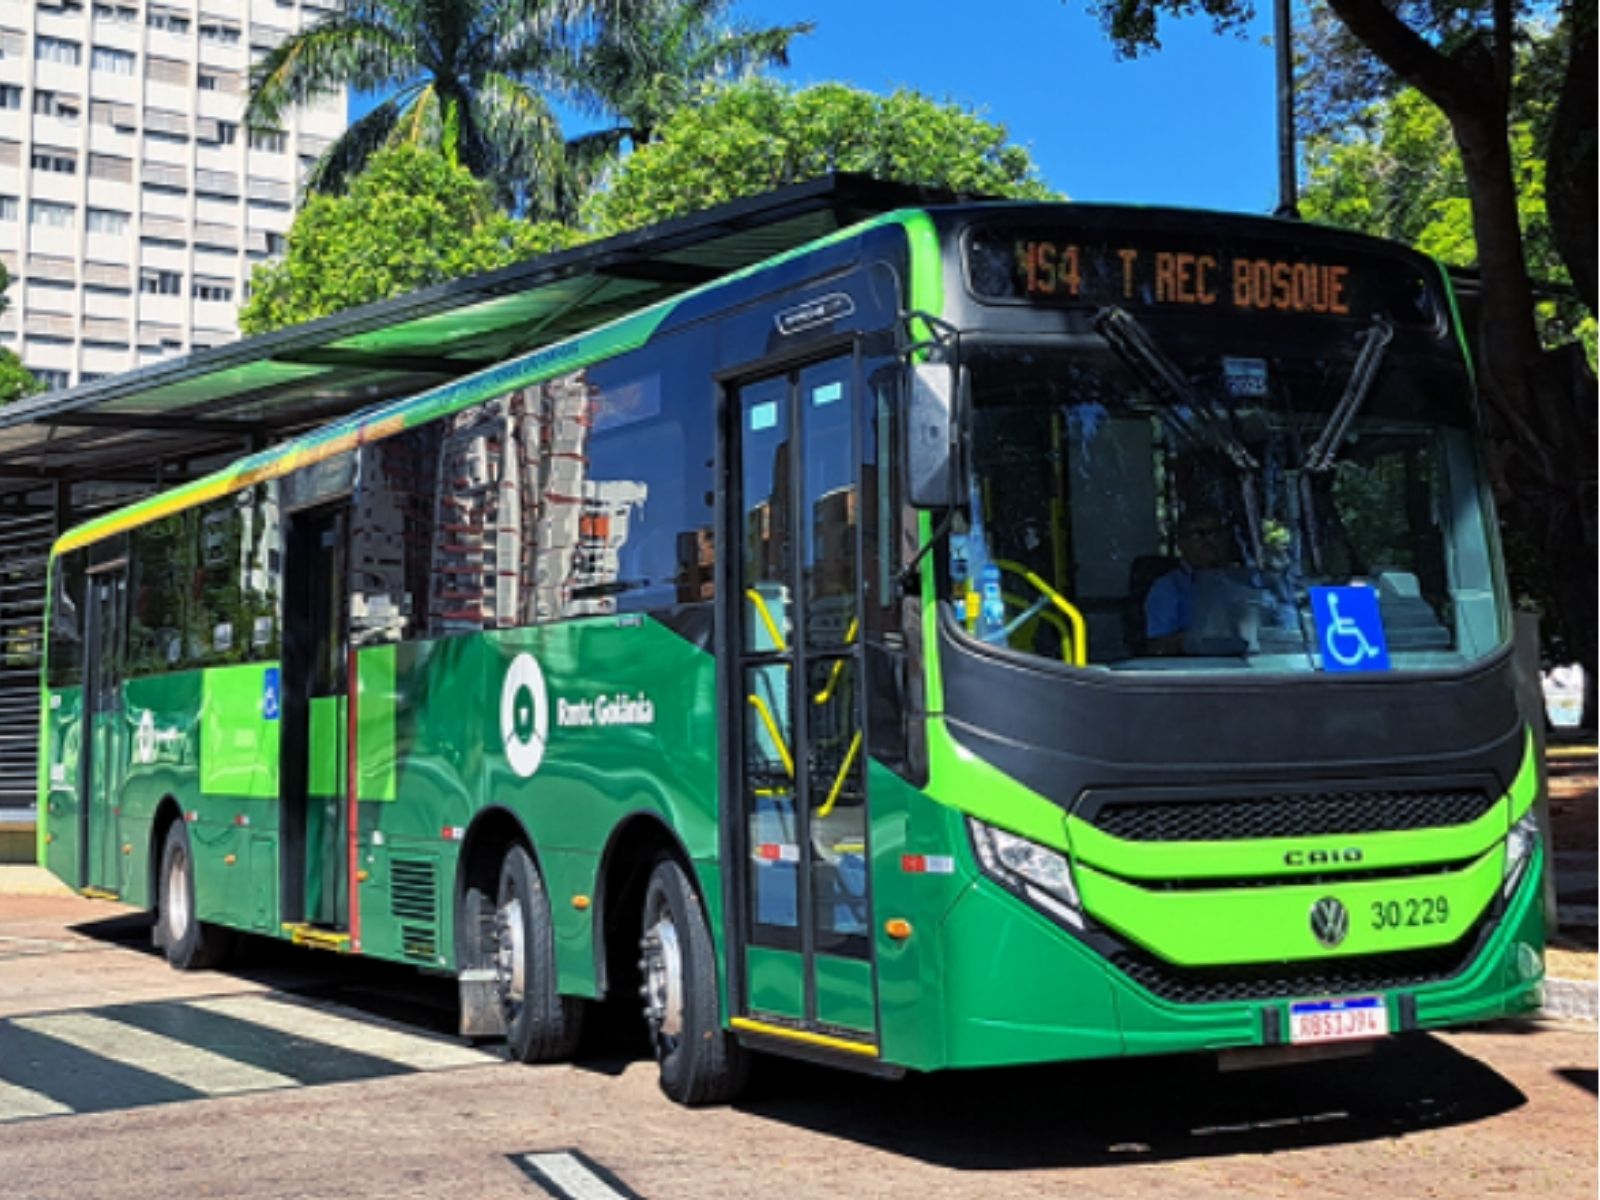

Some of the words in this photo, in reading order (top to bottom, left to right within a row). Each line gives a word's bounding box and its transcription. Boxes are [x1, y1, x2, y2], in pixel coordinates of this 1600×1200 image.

[1117, 248, 1138, 299] T
[1154, 251, 1217, 305] REC
[1232, 257, 1350, 315] BOSQUE
[1283, 848, 1364, 867] CAIO
